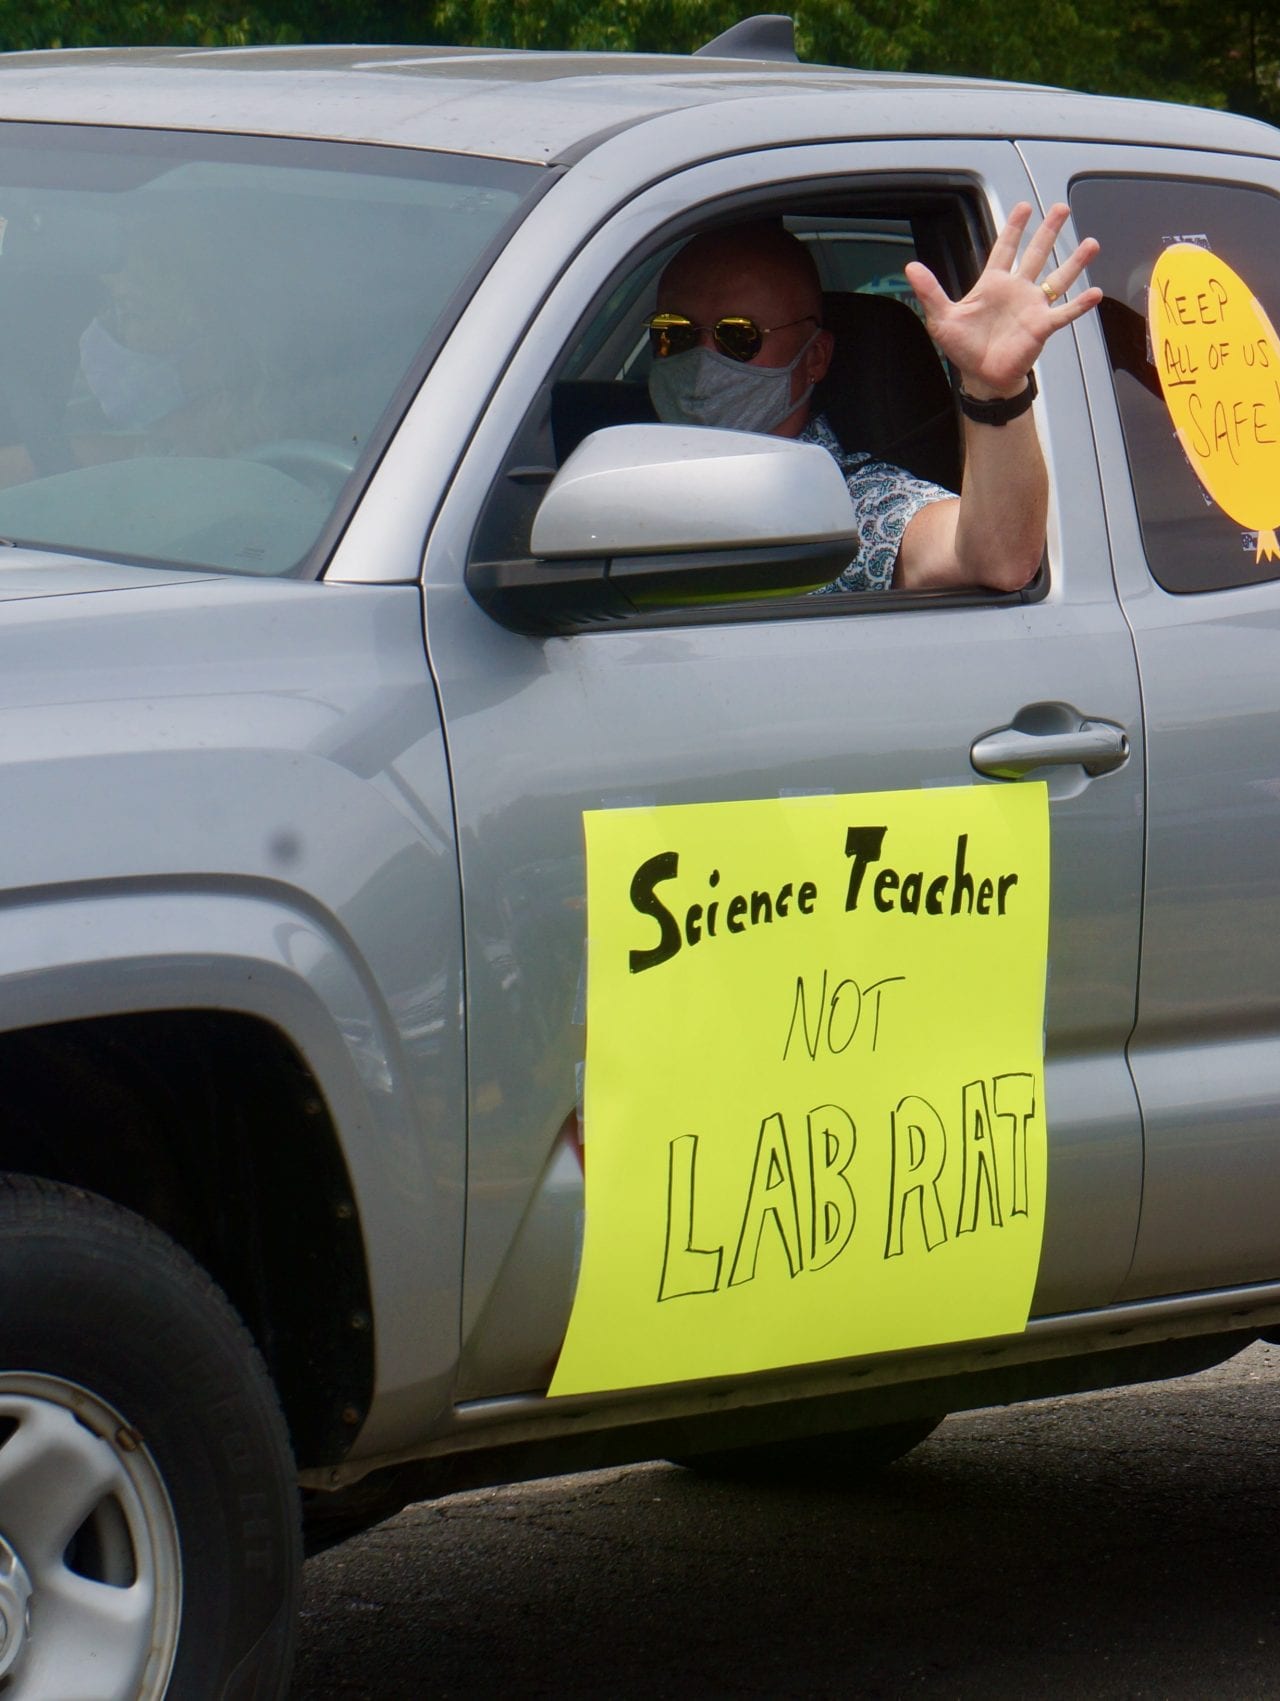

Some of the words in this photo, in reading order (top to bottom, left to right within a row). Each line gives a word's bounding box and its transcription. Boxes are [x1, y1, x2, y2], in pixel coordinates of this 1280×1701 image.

[1156, 278, 1228, 327] KEEP
[1163, 338, 1199, 382] ALL
[1208, 342, 1231, 370] OF
[1243, 339, 1270, 368] US
[628, 850, 818, 974] Science
[844, 825, 1019, 917] Teacher
[782, 968, 906, 1062] NOT
[656, 1103, 858, 1303] LAB
[883, 1071, 1036, 1260] RAT
